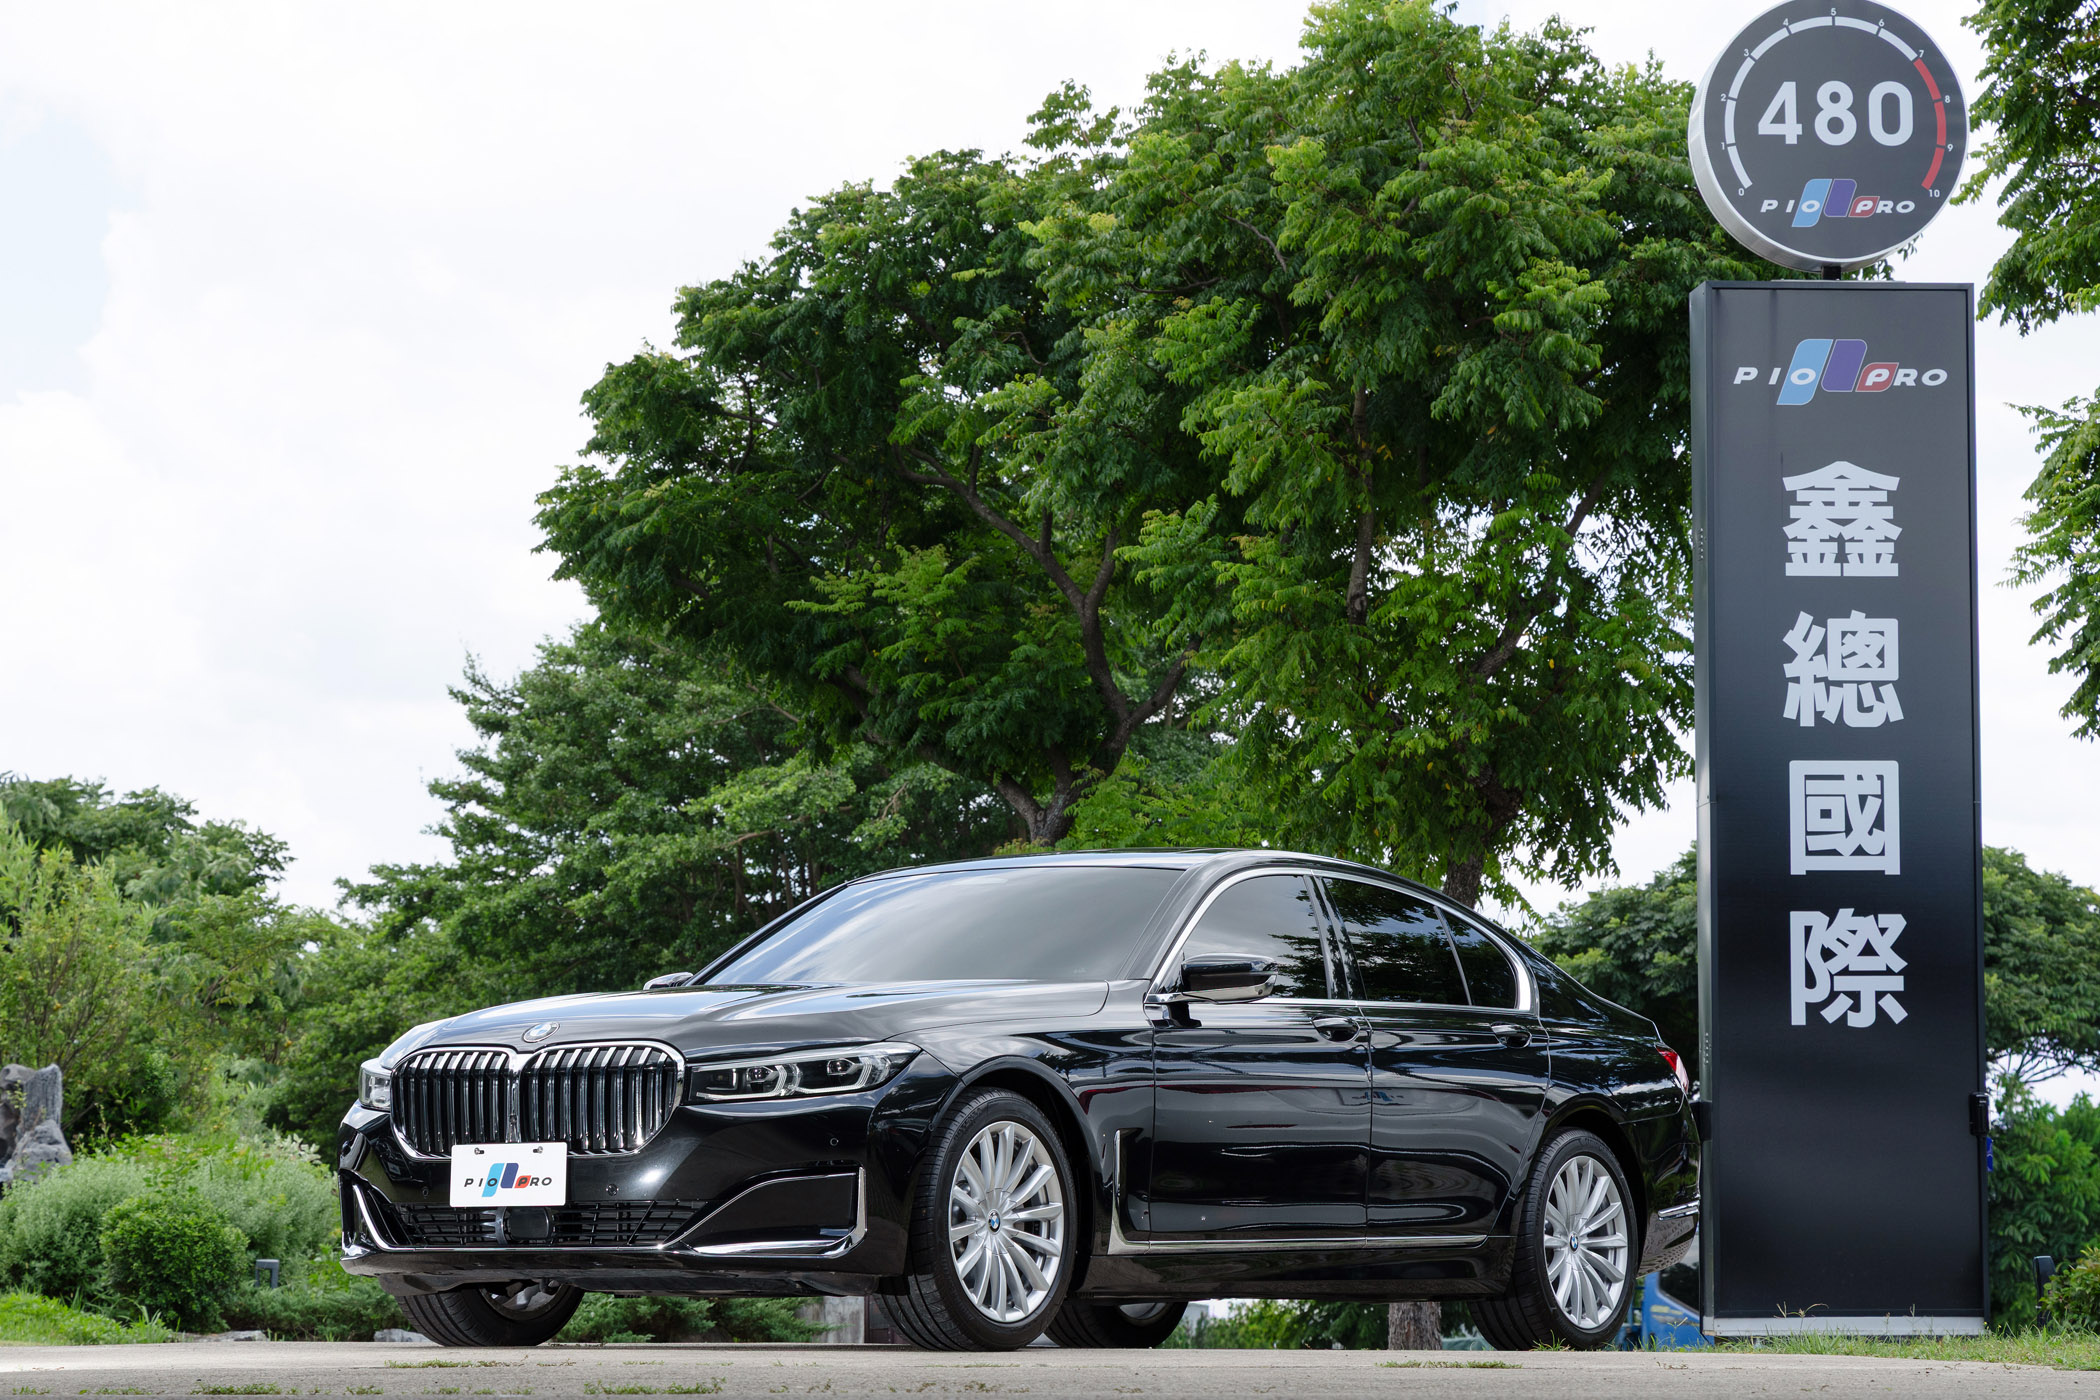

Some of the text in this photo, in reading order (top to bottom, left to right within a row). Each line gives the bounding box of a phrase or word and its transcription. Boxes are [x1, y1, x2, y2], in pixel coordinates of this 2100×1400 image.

[1830, 7, 1837, 16] 5
[1782, 17, 1790, 27] 4
[1878, 18, 1885, 28] 6
[1743, 48, 1750, 57] 3
[1918, 49, 1925, 58] 7
[1720, 93, 1727, 102] 2
[1944, 94, 1951, 104] 8
[1758, 80, 1914, 146] 480
[1720, 141, 1726, 151] 1
[1947, 143, 1954, 152] 9
[1738, 187, 1745, 197] 0
[1928, 189, 1941, 198] 10
[1782, 460, 1909, 1028] 鑫總國際
